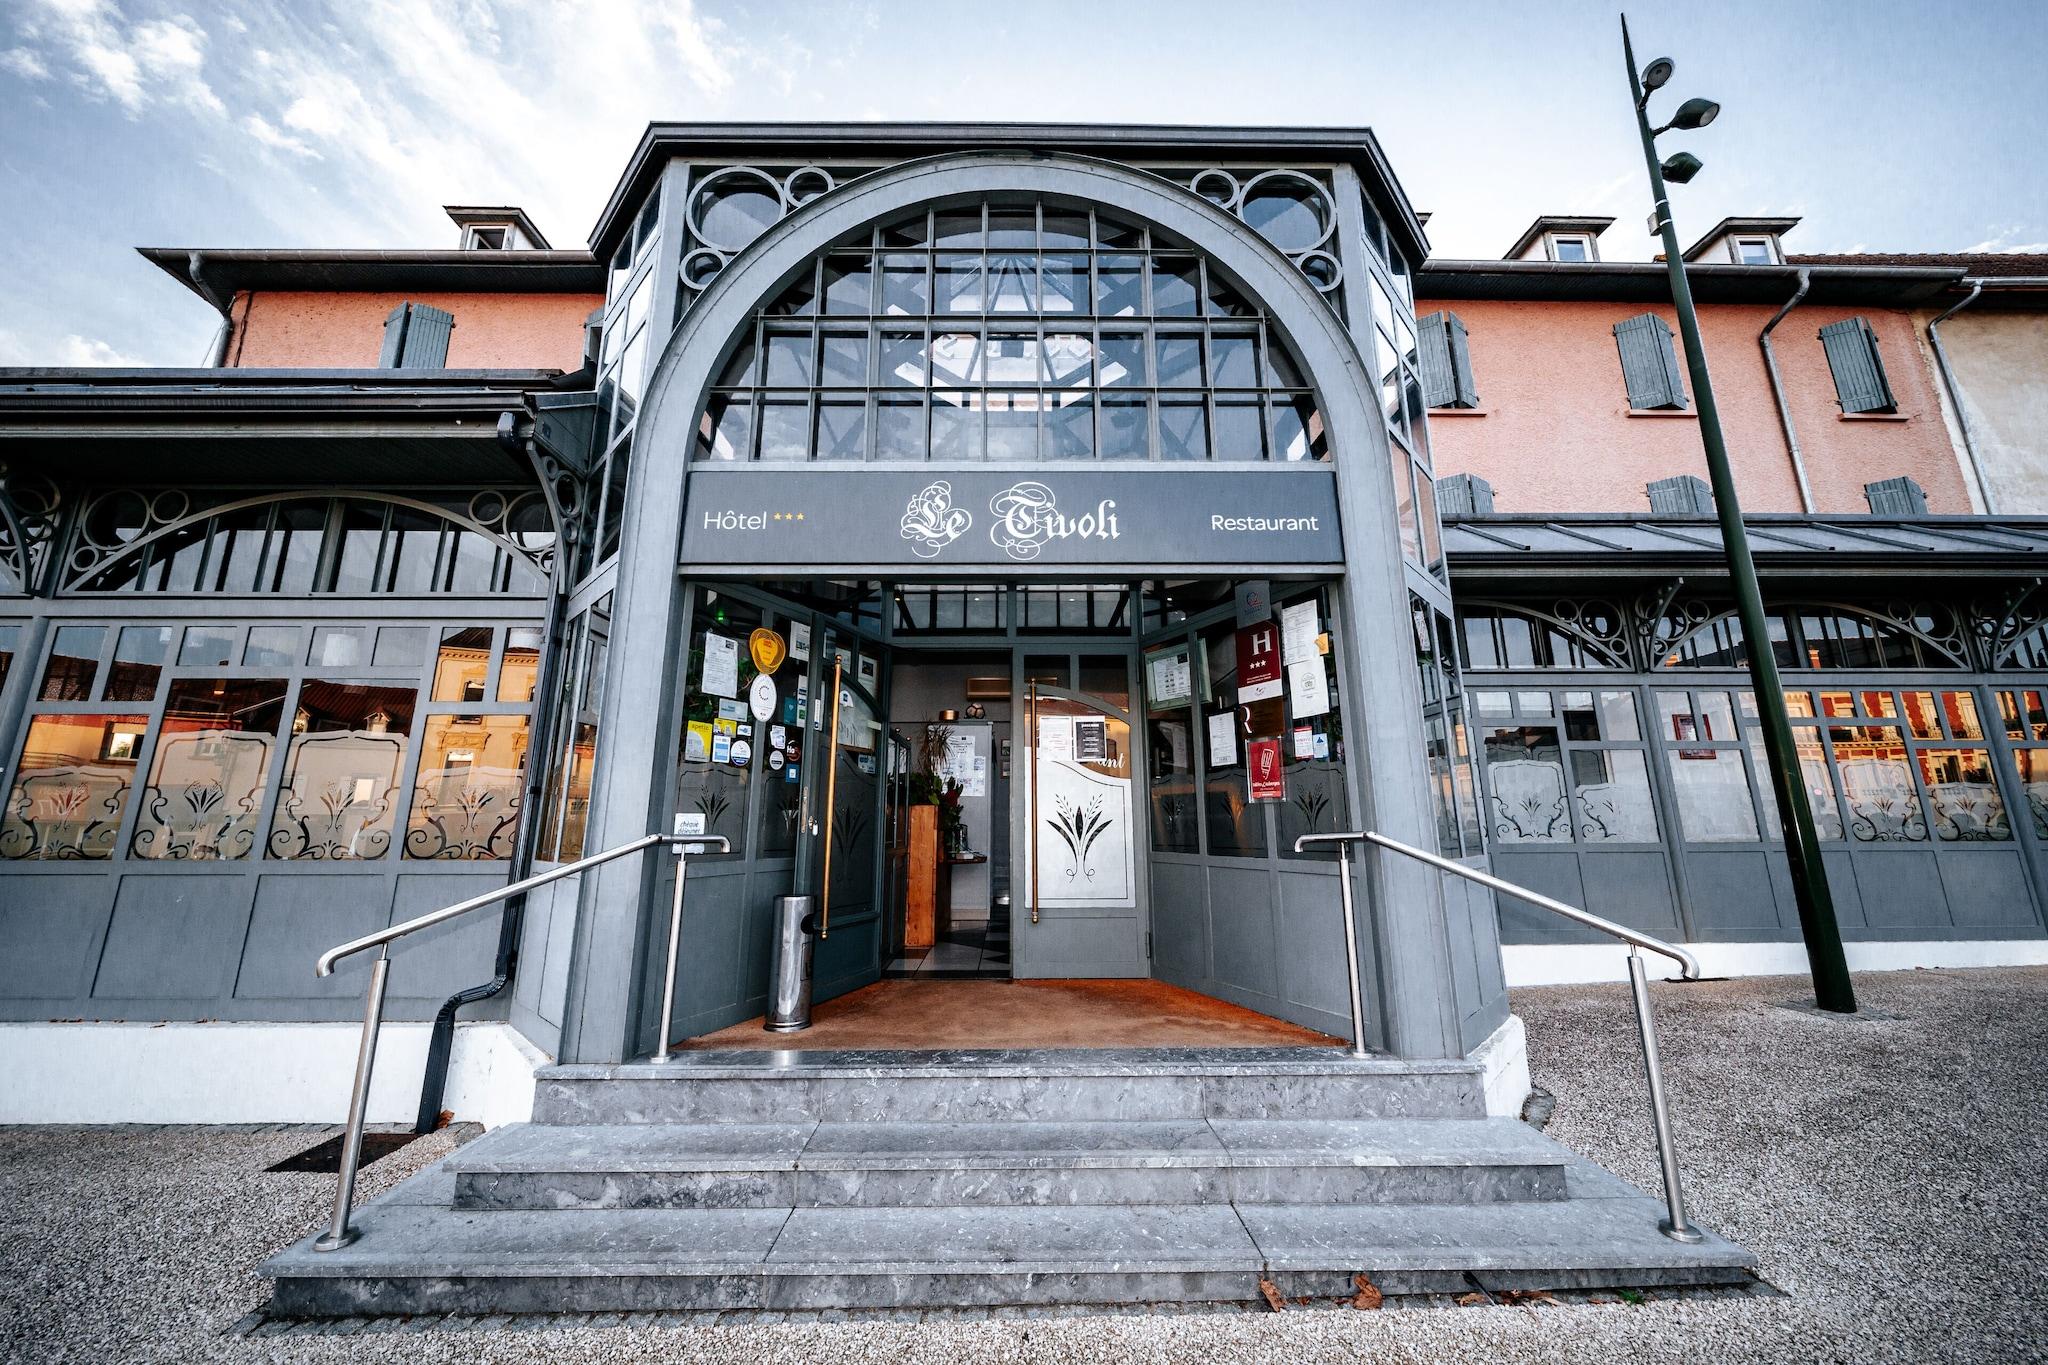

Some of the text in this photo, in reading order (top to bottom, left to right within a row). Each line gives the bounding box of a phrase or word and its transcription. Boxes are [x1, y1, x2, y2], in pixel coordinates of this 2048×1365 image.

[703, 510, 767, 530] Hôtel
[901, 480, 1121, 561] Le Tivoli
[1211, 514, 1319, 531] Restaurant
[1252, 629, 1273, 656] H
